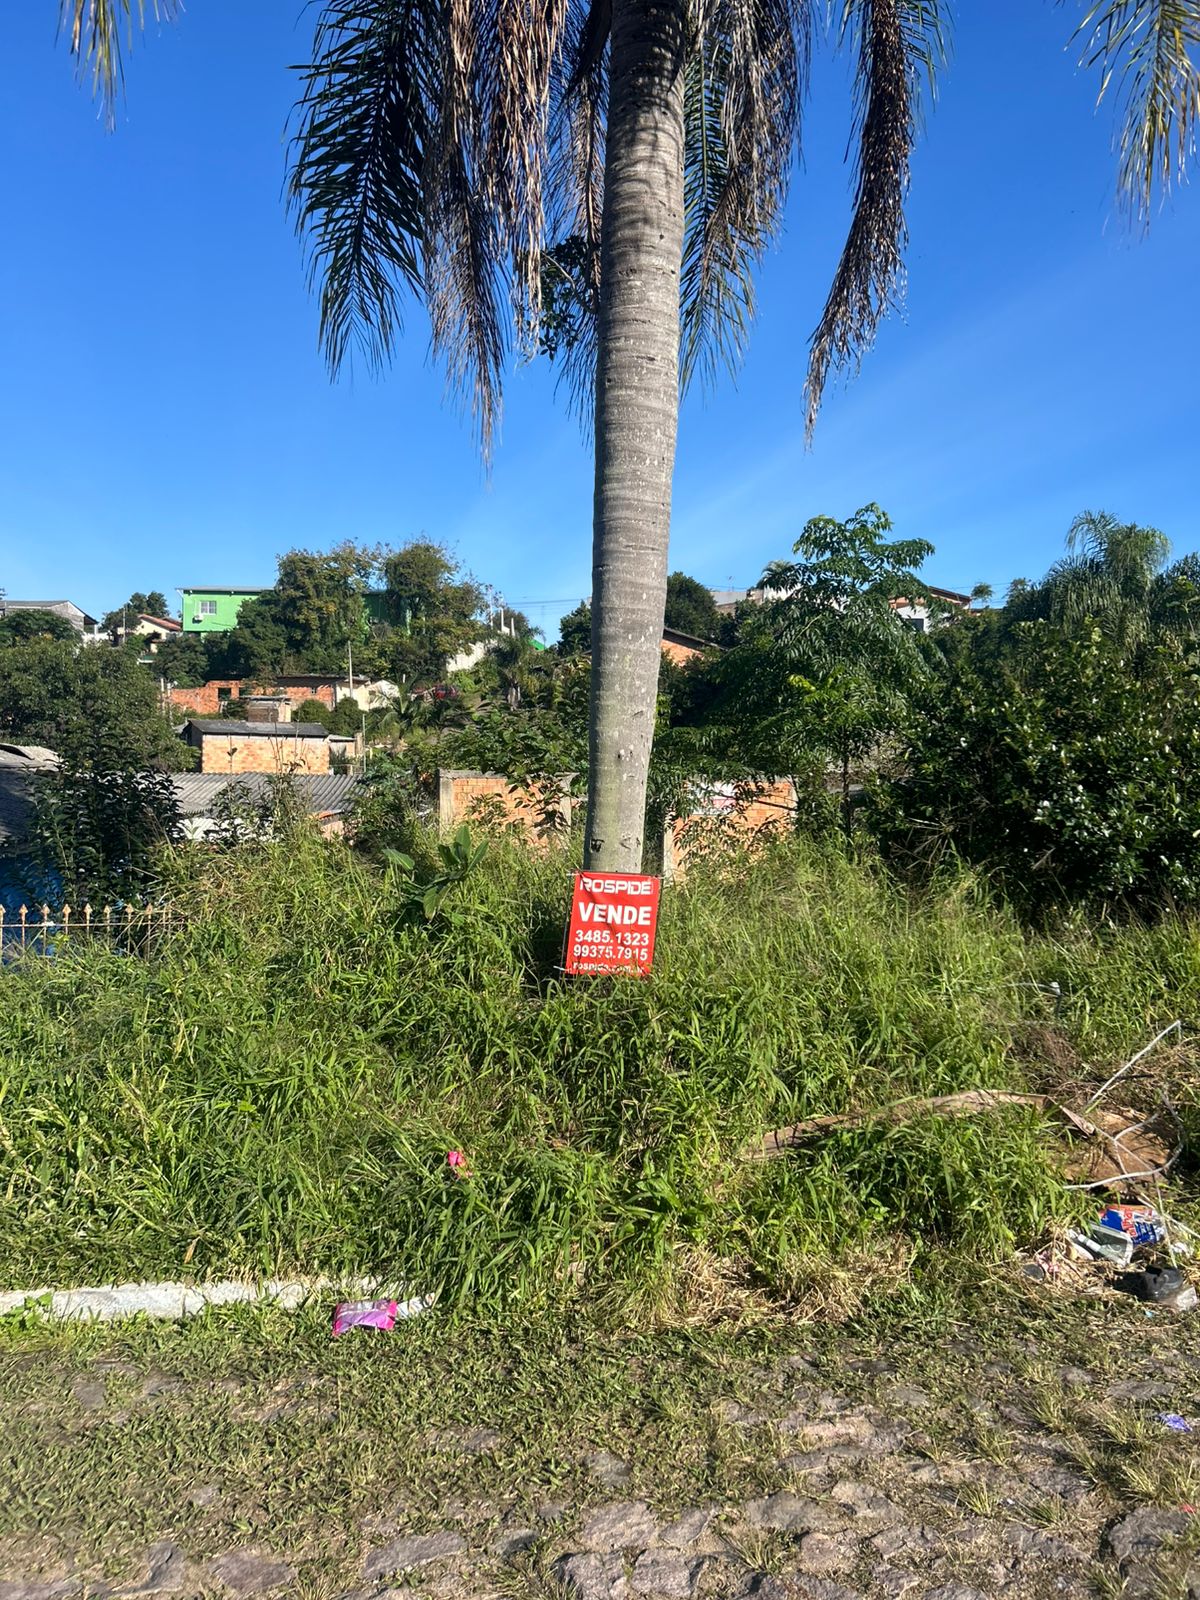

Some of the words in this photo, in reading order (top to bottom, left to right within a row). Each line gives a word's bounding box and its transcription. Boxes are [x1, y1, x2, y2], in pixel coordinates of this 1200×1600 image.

[580, 877, 653, 895] ROSPIDE
[578, 902, 652, 925] VENDE
[575, 930, 649, 946] 3485.1323
[573, 944, 648, 961] 99375.7915
